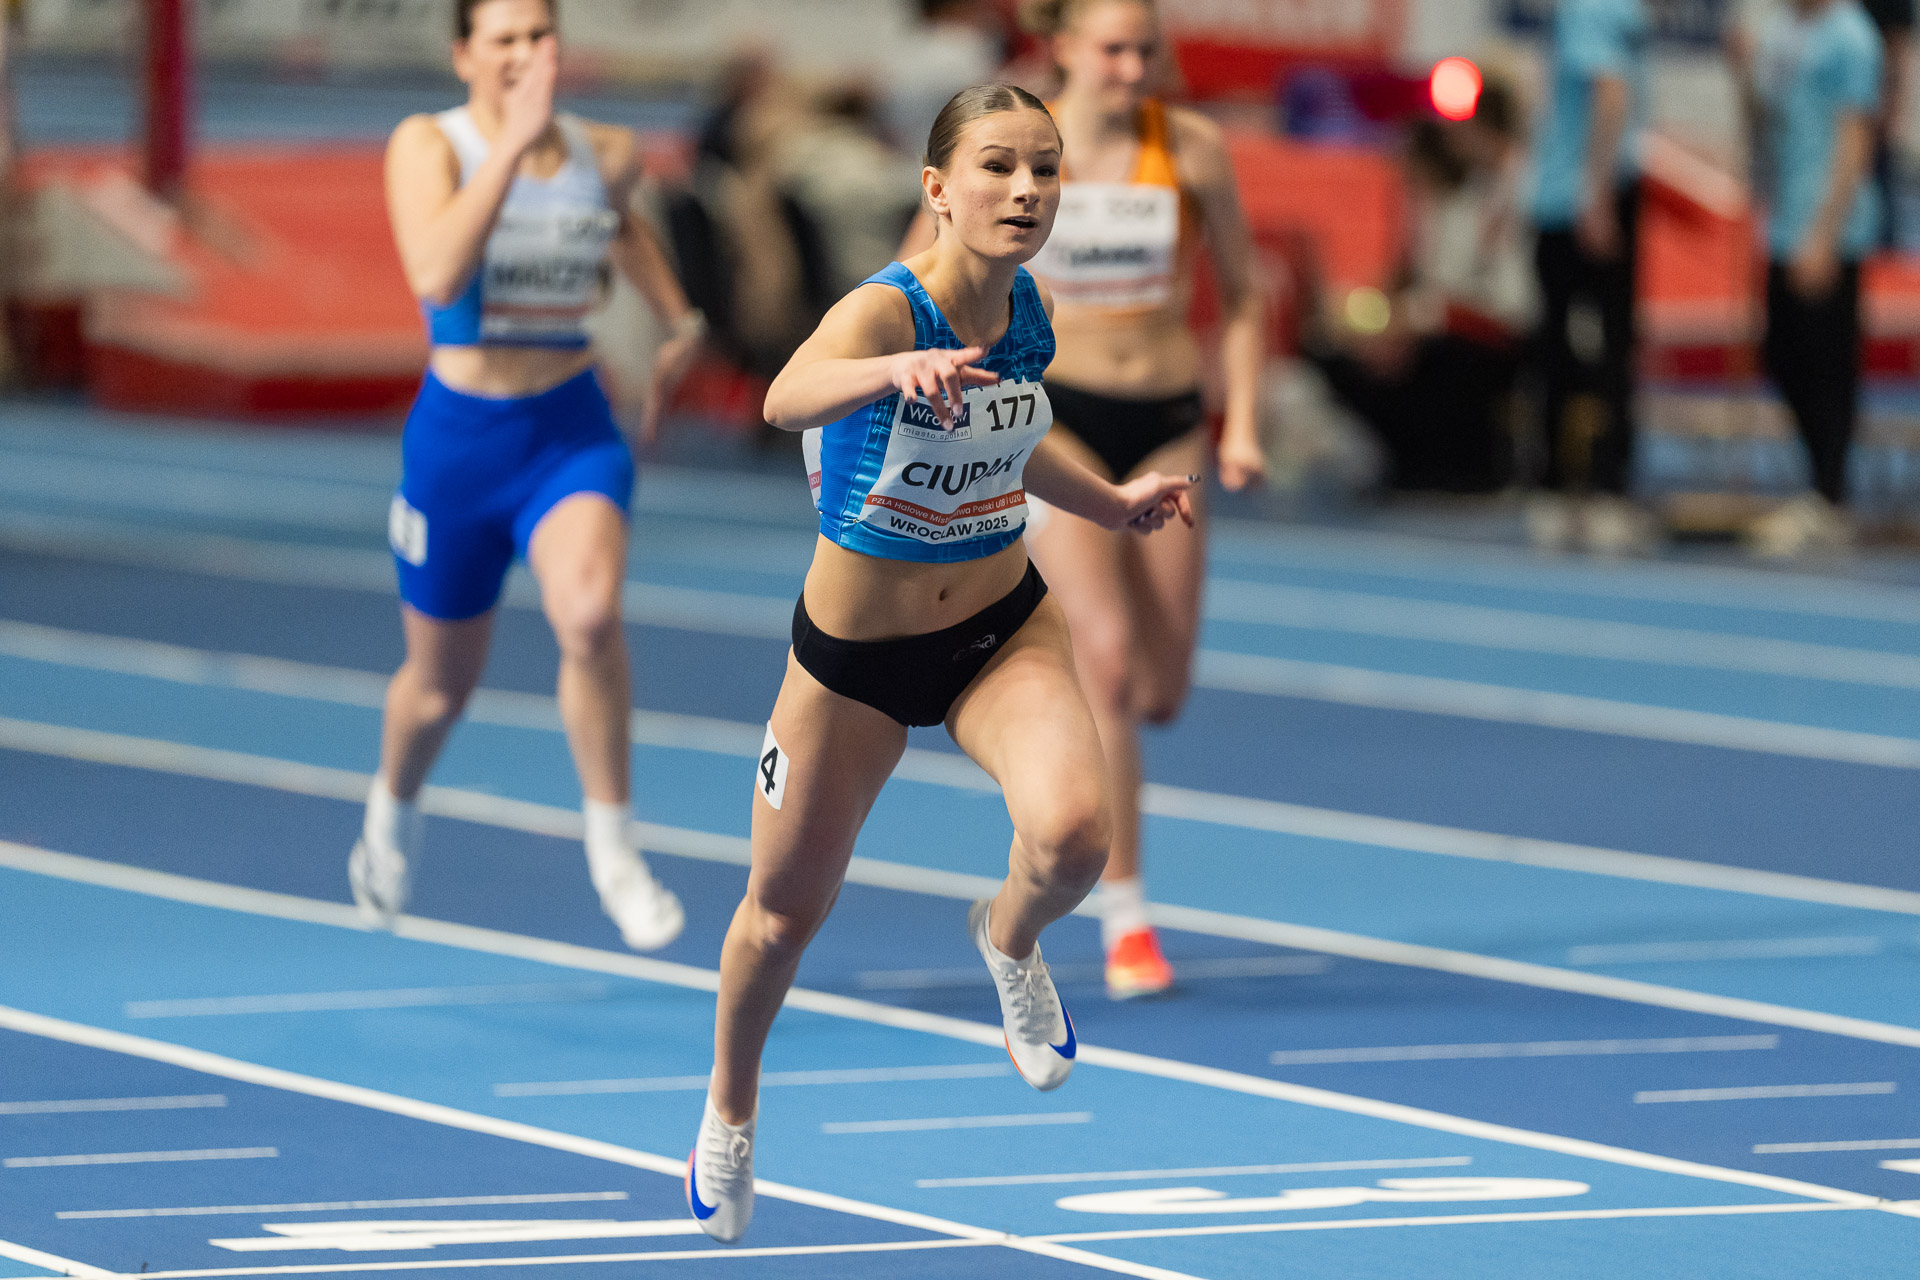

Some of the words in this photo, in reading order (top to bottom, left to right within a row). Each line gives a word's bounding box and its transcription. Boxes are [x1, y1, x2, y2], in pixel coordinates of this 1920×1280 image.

[986, 394, 1035, 431] 177
[903, 427, 936, 439] miasto
[871, 497, 892, 507] PZLA
[894, 501, 929, 519] Halowe
[972, 501, 995, 514] Polski
[1009, 493, 1022, 505] U20
[975, 515, 1009, 533] 2025
[760, 745, 779, 795] 4
